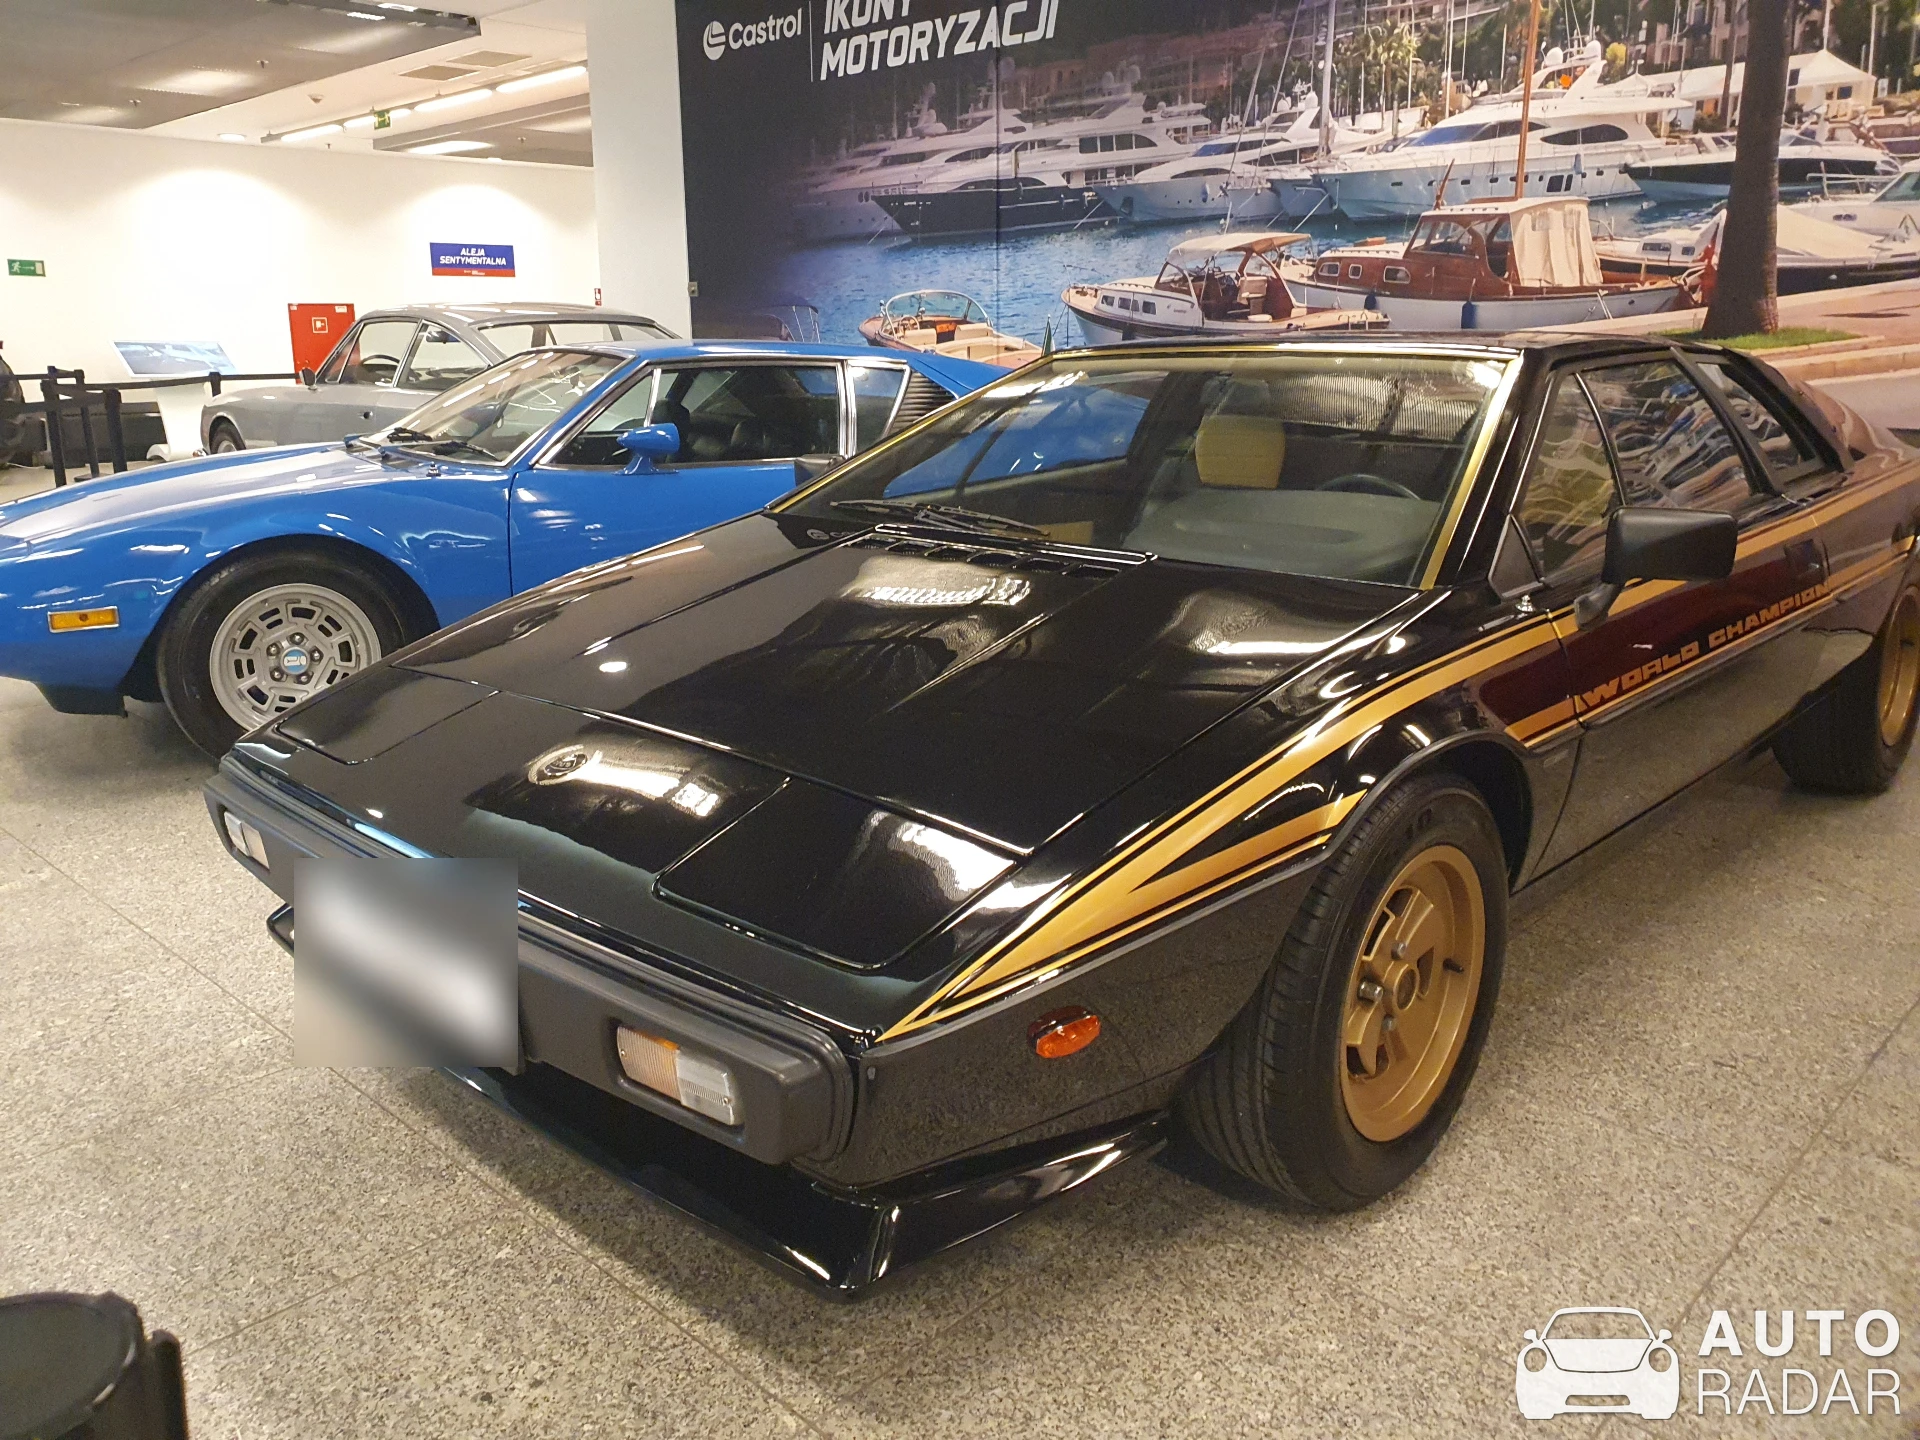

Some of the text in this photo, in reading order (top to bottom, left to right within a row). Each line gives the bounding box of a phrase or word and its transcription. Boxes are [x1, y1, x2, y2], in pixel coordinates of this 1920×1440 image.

[728, 8, 802, 50] Castrol
[819, 0, 1060, 81] MOTORYZACJI
[439, 256, 507, 266] SENTYMENTALNA
[460, 247, 486, 257] ALEJA
[1582, 583, 1831, 707] WORLD CHAMPION
